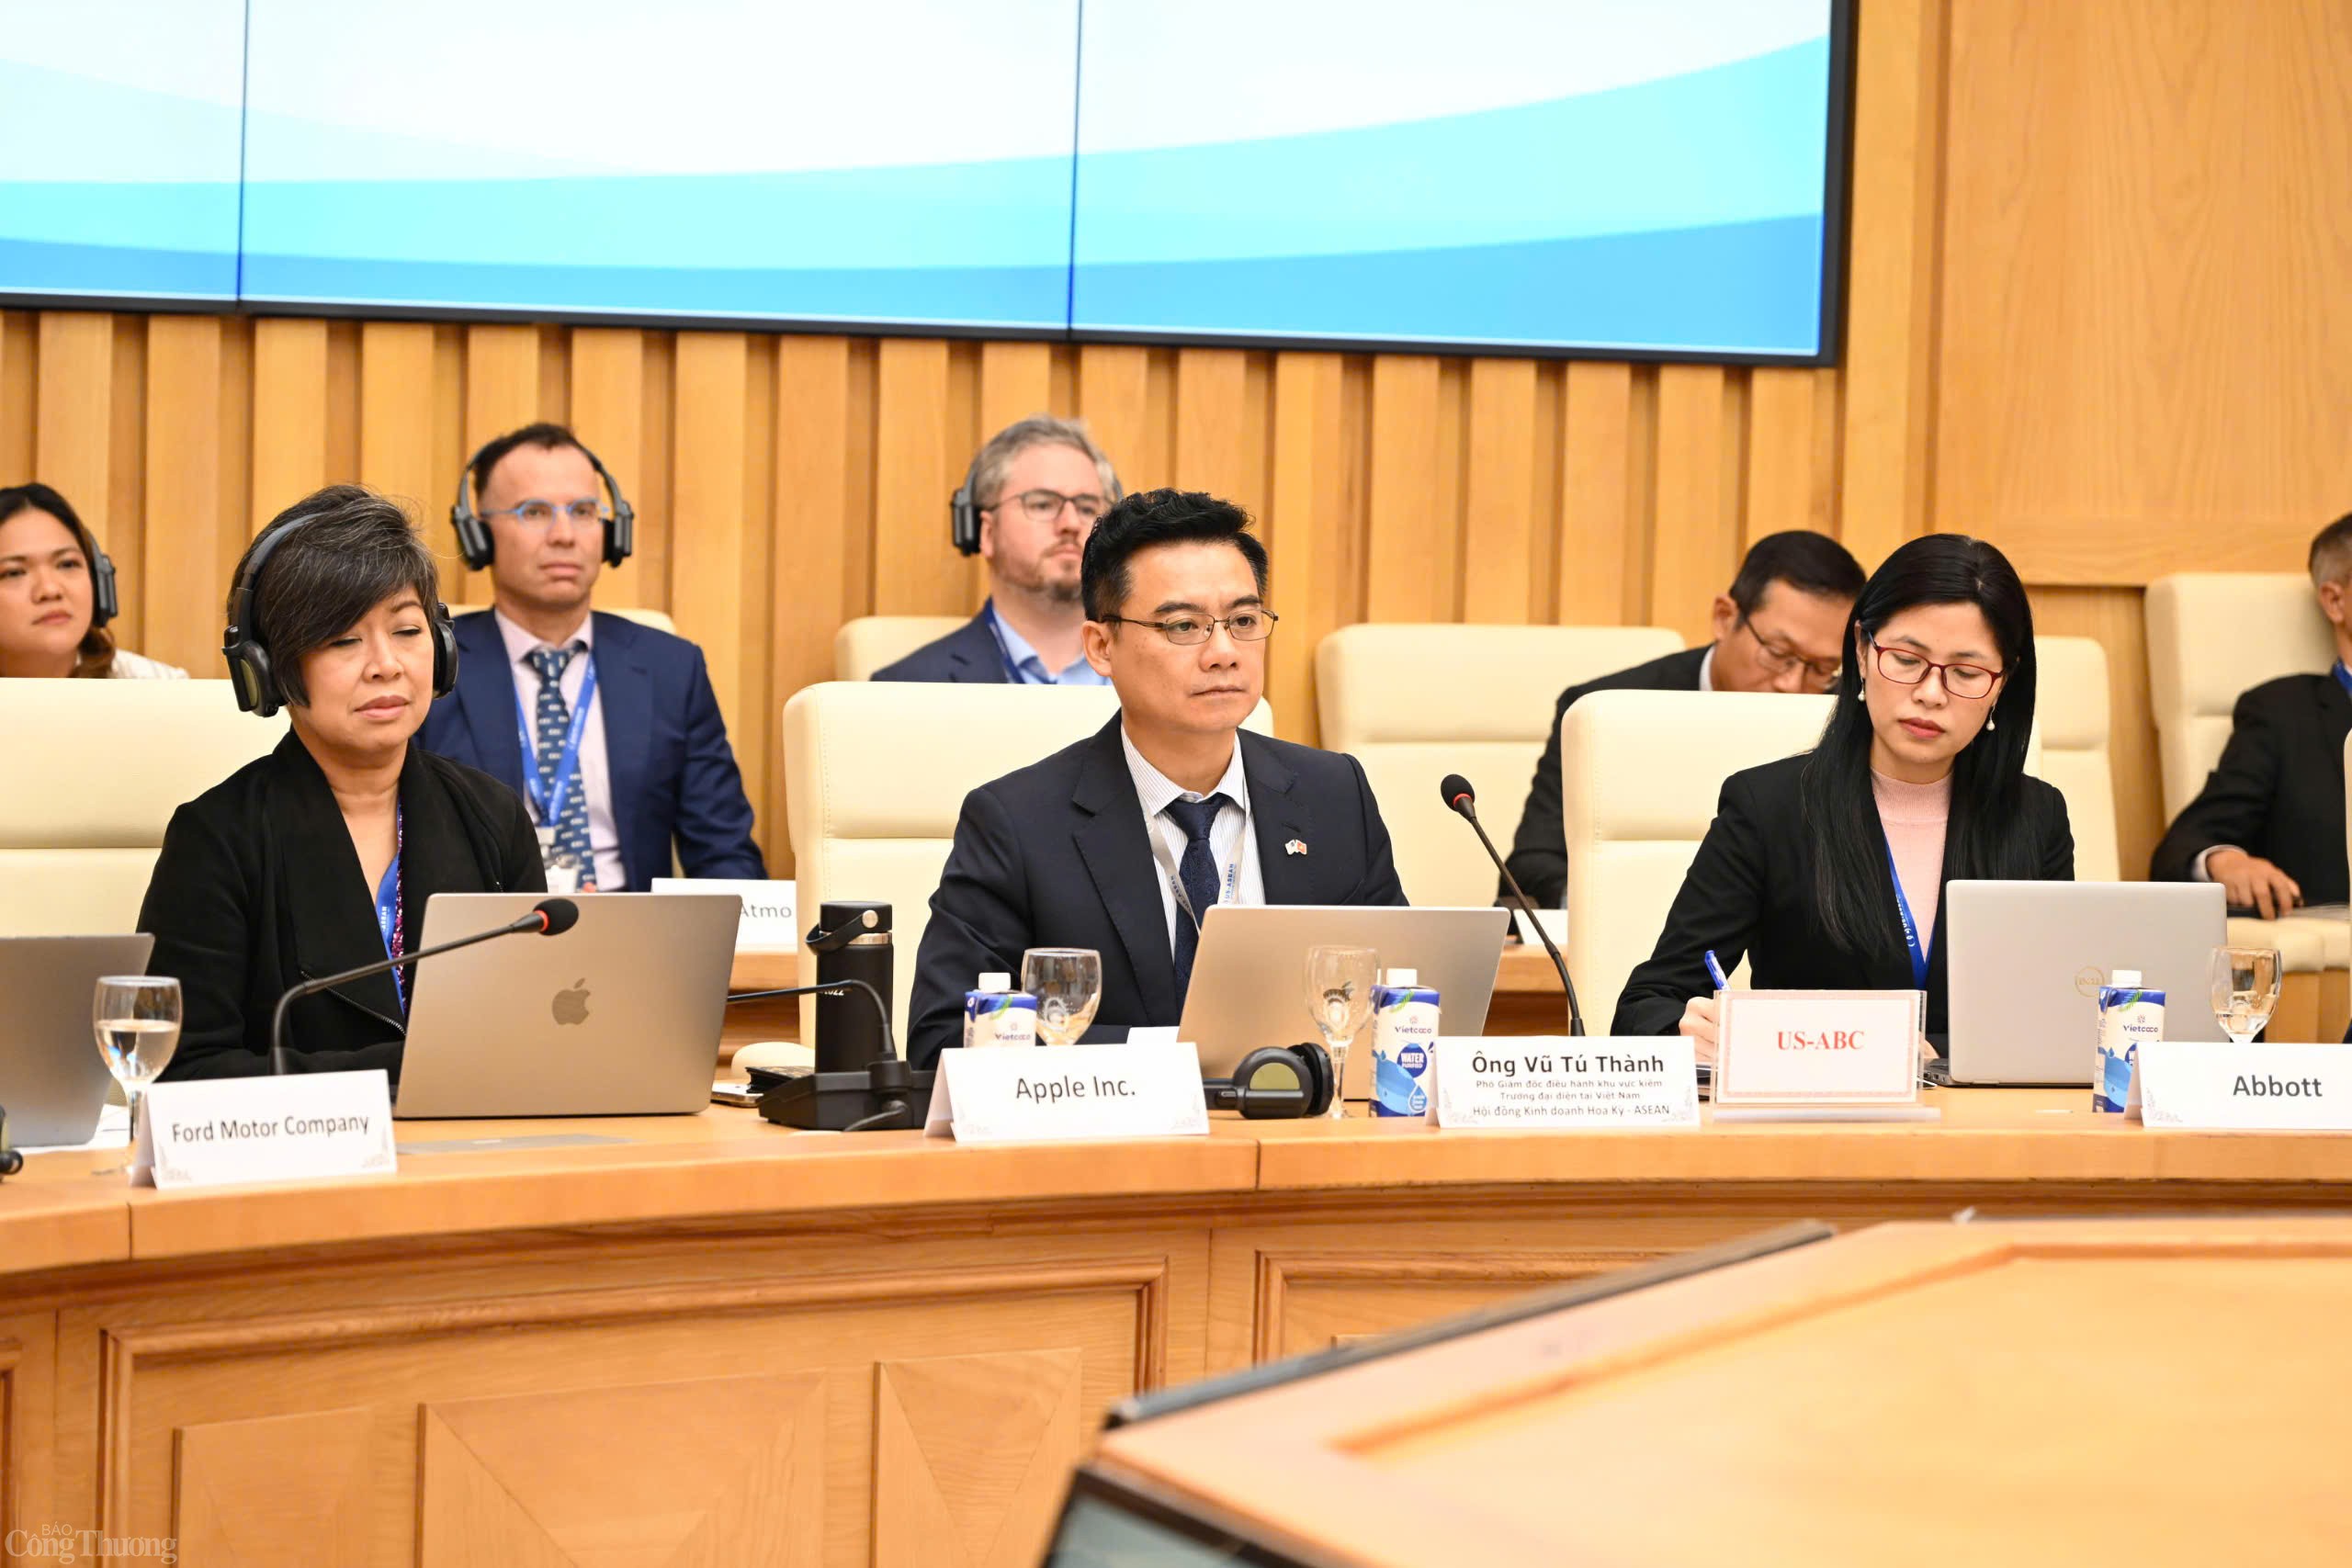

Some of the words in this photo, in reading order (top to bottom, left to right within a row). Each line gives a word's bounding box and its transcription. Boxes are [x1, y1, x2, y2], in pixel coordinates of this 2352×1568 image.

[1395, 1026, 1432, 1034] Vietcoco
[2122, 1024, 2159, 1033] Vietcoco
[1777, 1030, 1865, 1050] US-ABC
[1400, 1053, 1424, 1064] WATER
[1472, 1050, 1516, 1077] Ông
[1524, 1055, 1553, 1073] Vũ
[1560, 1054, 1588, 1073] Tú
[1595, 1054, 1664, 1073] Thành
[1015, 1074, 1086, 1104] Apple
[1092, 1075, 1136, 1097] Inc.
[2233, 1074, 2323, 1098] Abbott
[1618, 1091, 1641, 1100] Nam
[1524, 1105, 1548, 1115] Kinh
[1551, 1105, 1585, 1115] doanh
[1588, 1105, 1609, 1115] Hoa
[1634, 1104, 1670, 1115] ASEAN
[172, 1120, 214, 1143] Ford
[220, 1119, 278, 1140] Motor
[284, 1114, 369, 1135] Company
